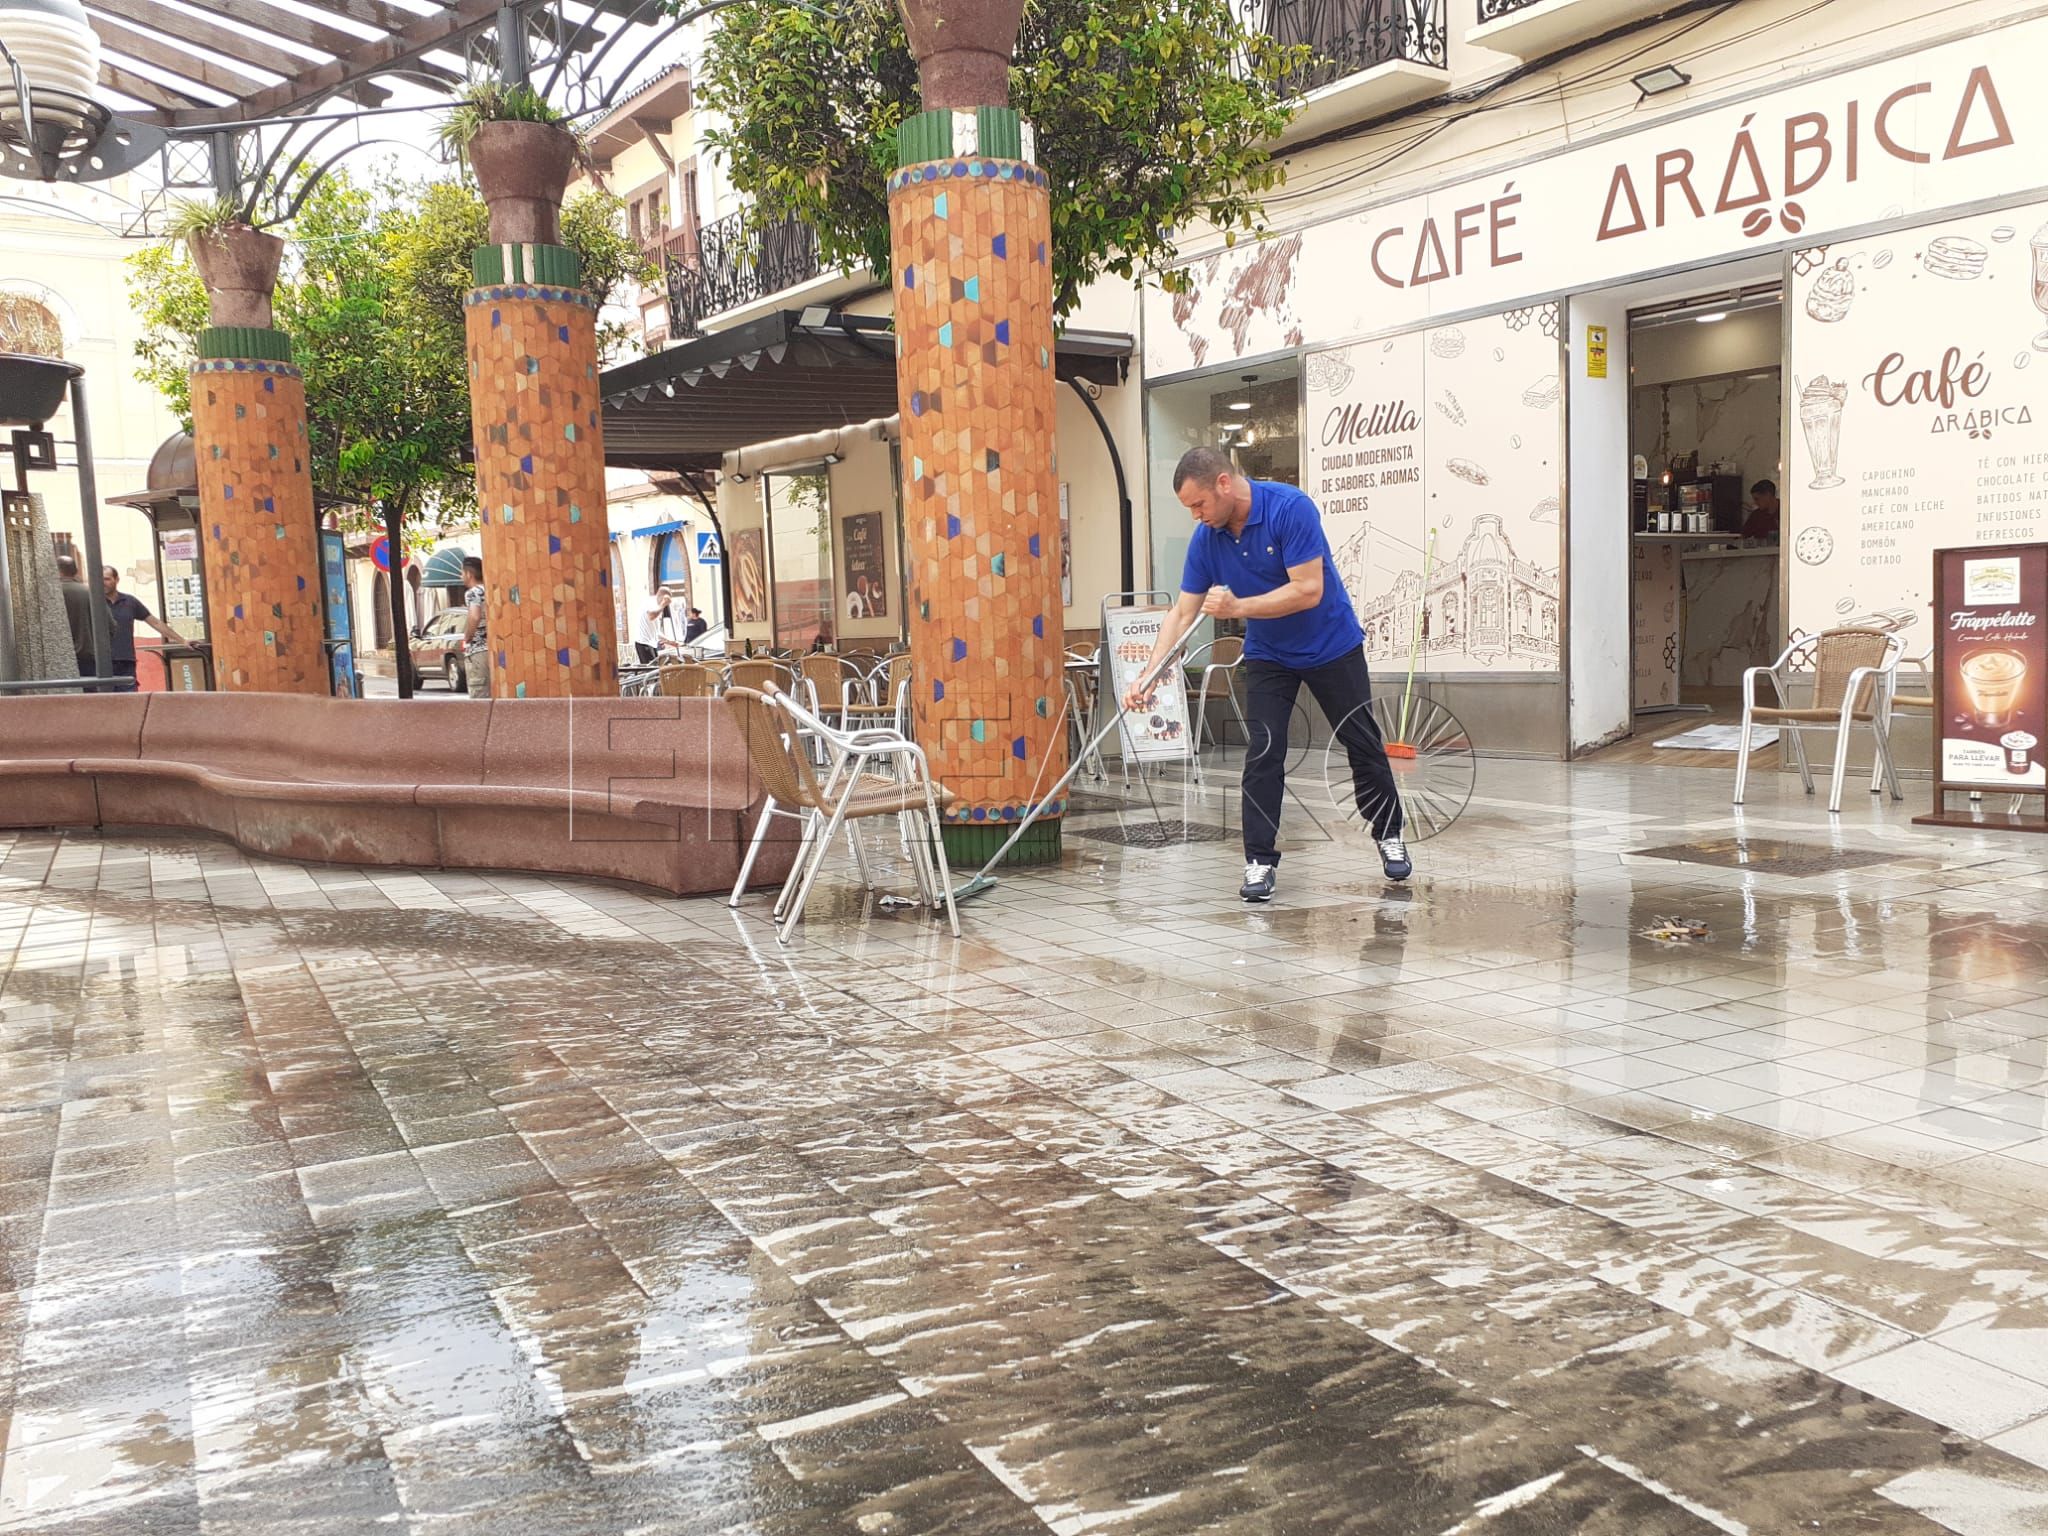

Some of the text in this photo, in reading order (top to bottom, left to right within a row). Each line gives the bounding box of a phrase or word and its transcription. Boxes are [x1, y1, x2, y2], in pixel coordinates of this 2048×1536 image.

[1370, 64, 2015, 289] CAFÉ ARÁBICA
[1862, 346, 1991, 409] Café
[1321, 400, 1422, 447] Melilla
[1930, 405, 2032, 433] ARÁBICA
[1321, 445, 1414, 472] CIUDAD MODERNISTA
[1997, 456, 2016, 467] CON
[1321, 467, 1420, 493] DE SABORES, AROMAS
[1862, 467, 1915, 481] CAPUCHINO
[1977, 472, 2035, 487] CHOCOLATE
[1861, 486, 1909, 498] MANCHADO
[1976, 492, 2022, 504] BATIDOS
[1321, 496, 1369, 516] Y COLORES
[1861, 500, 1945, 515] CAFÉ CON LECHE
[1976, 509, 2041, 522] INFUSIONES
[1861, 519, 1914, 532] AMERICANO
[1976, 527, 2034, 540] REFRESCOS
[1861, 536, 1896, 549] BOMBÓN
[1860, 554, 1902, 566] CORTADO
[1949, 610, 2036, 631] Frappélatte
[1122, 623, 1160, 635] GOFRES
[1948, 753, 2001, 761] PARA LLEVAR
